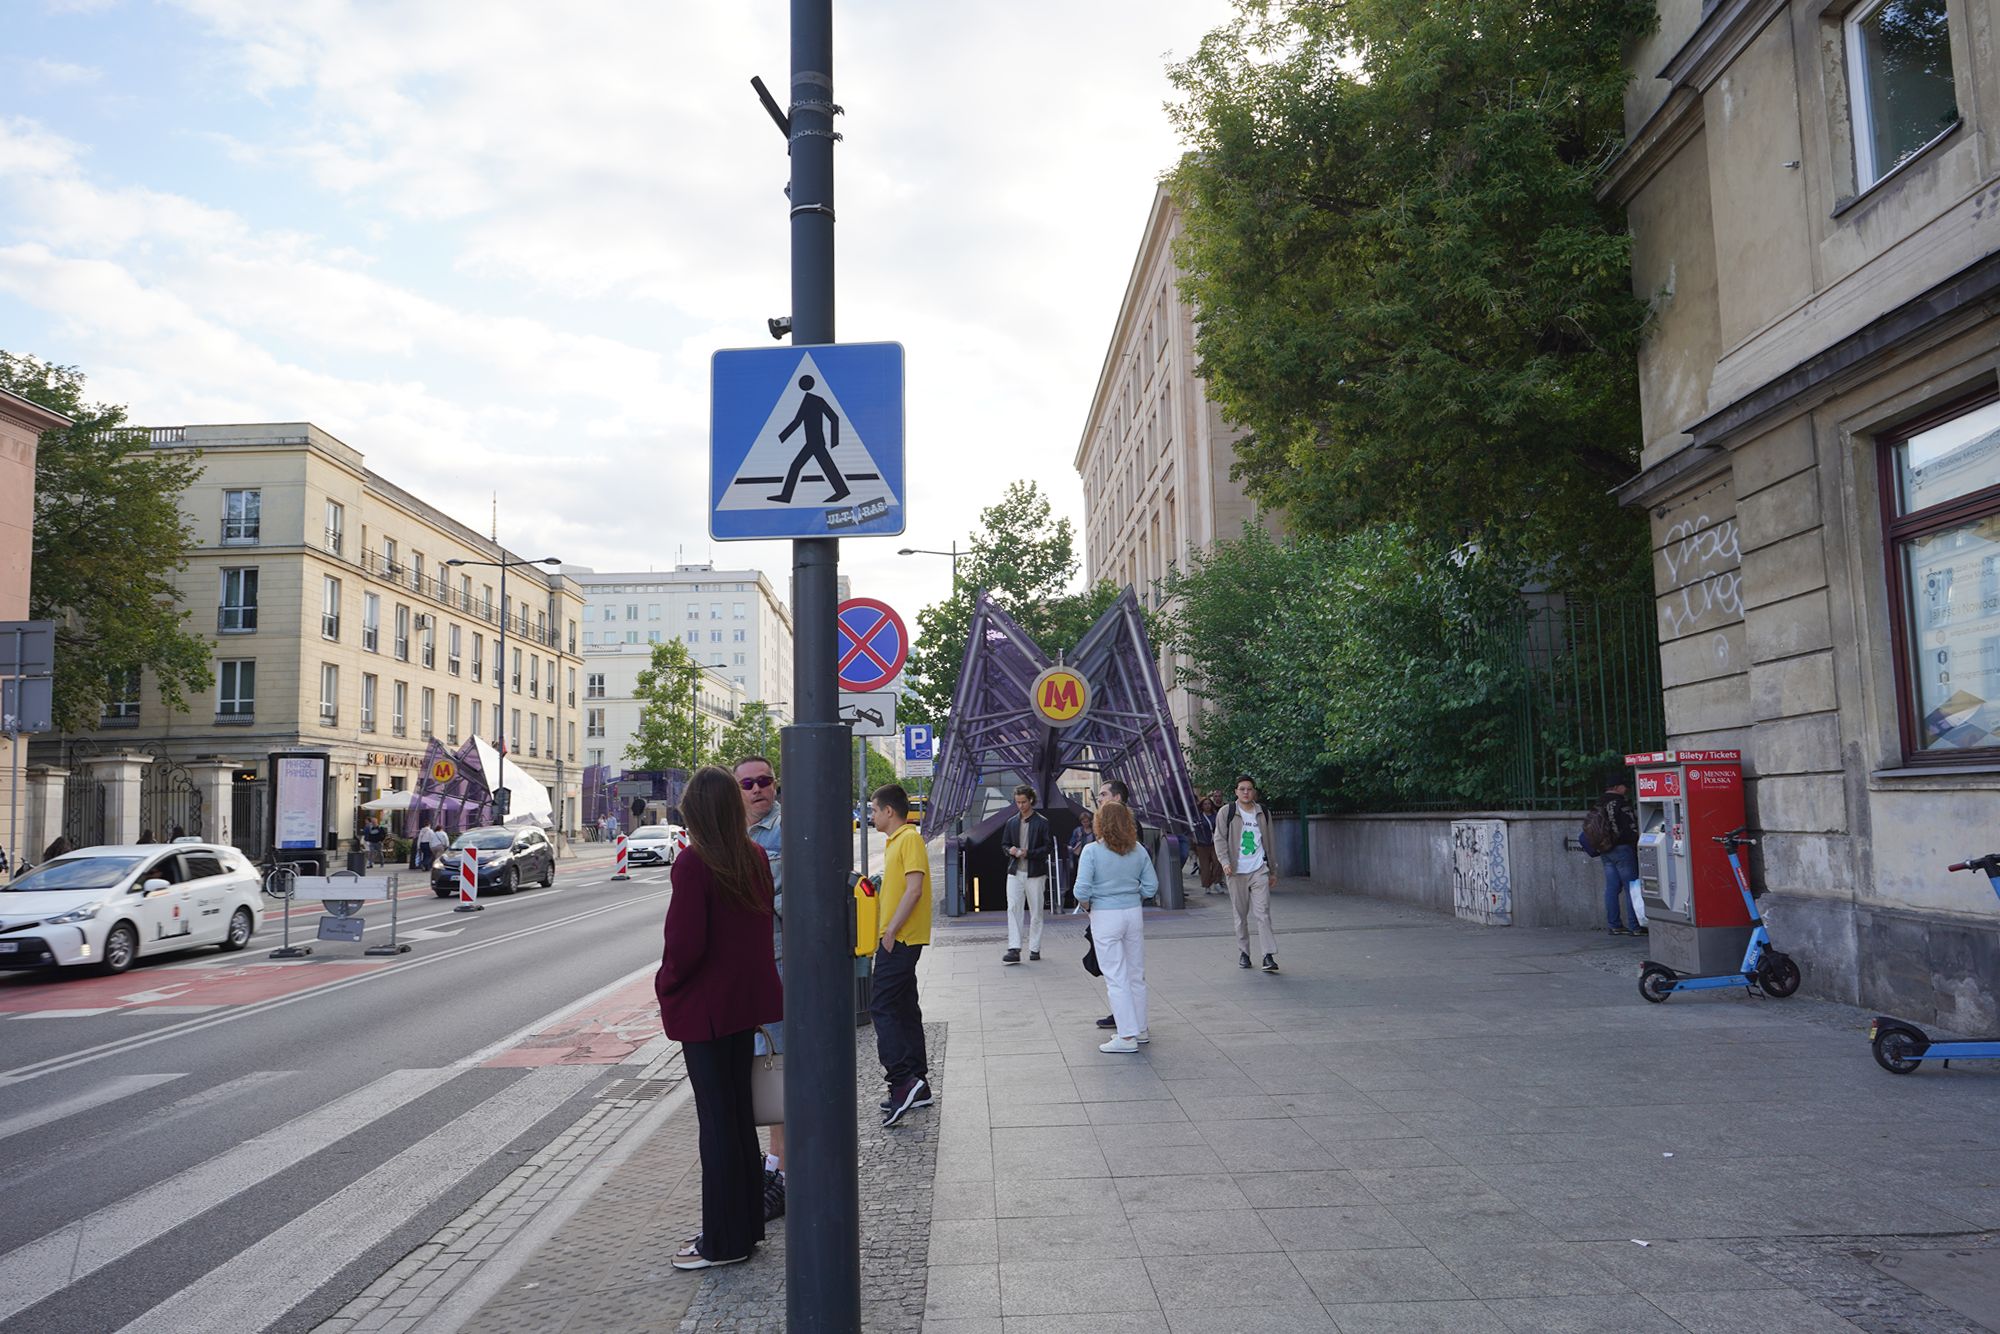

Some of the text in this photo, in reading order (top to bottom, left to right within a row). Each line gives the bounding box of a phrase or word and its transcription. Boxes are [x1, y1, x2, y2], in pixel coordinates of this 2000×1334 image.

[1044, 680, 1078, 711] M
[910, 728, 927, 750] P
[1680, 751, 1703, 760] Bilety
[1709, 751, 1738, 759] Tickets
[1640, 778, 1657, 792] Bilety
